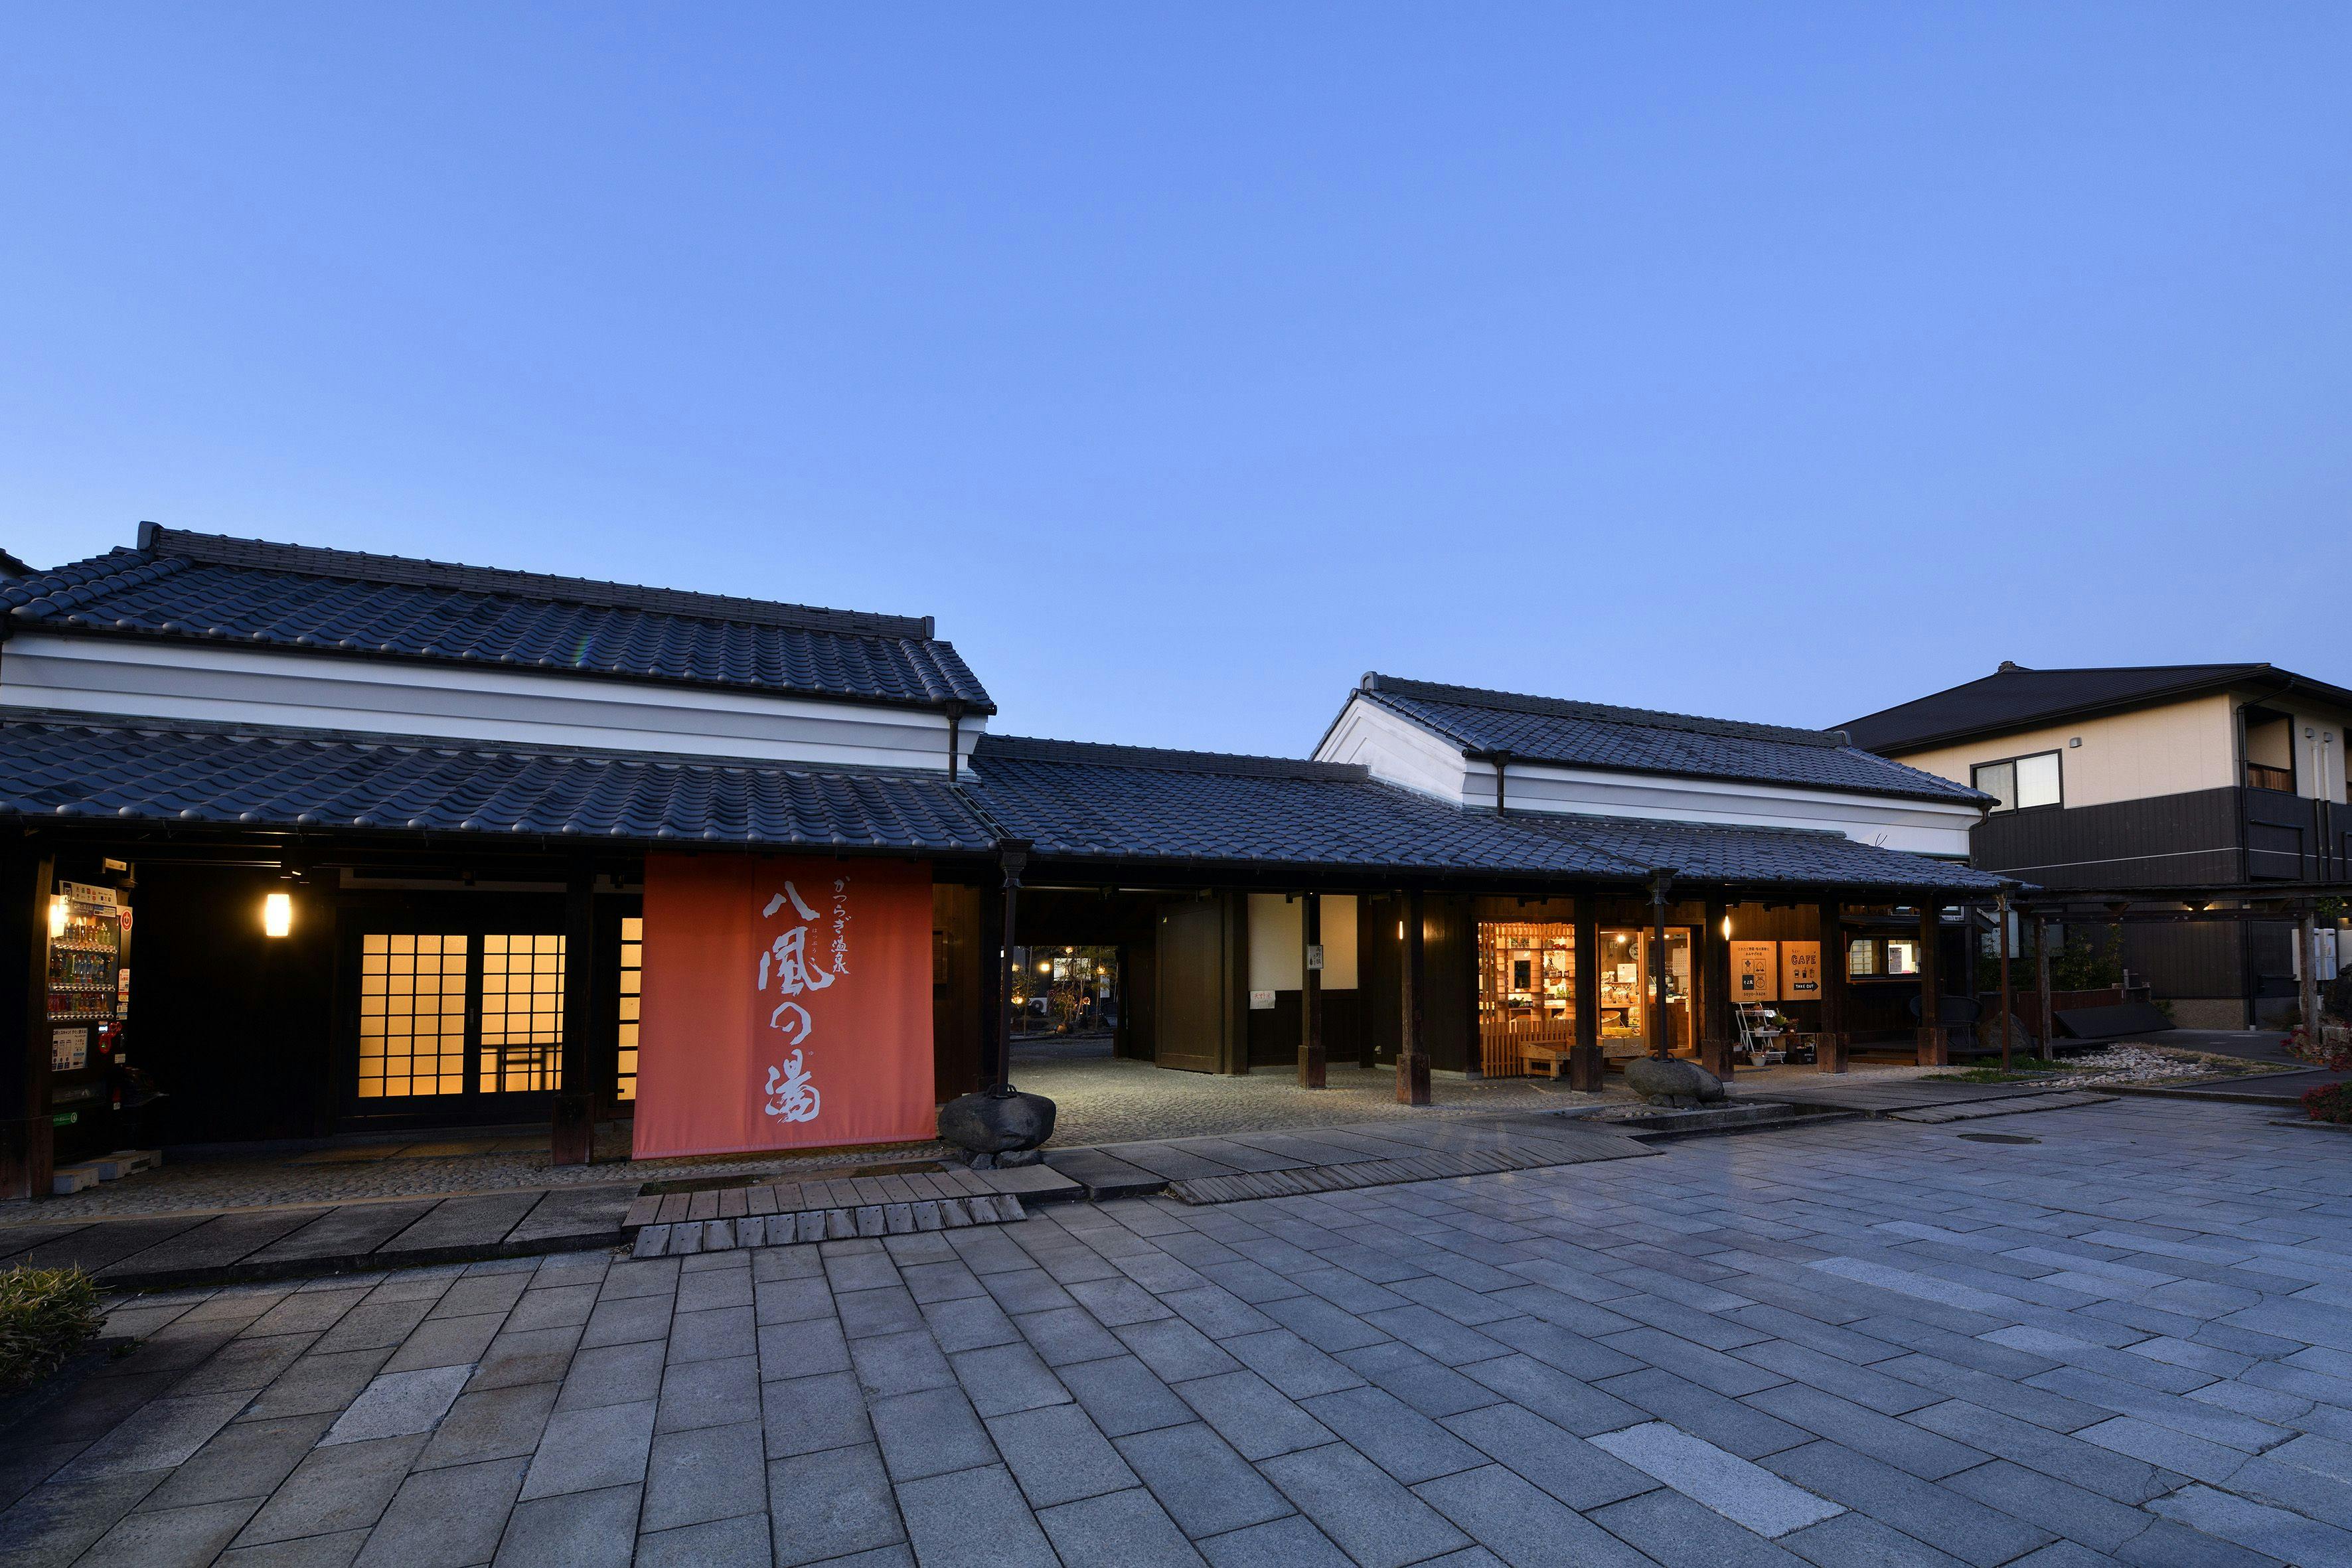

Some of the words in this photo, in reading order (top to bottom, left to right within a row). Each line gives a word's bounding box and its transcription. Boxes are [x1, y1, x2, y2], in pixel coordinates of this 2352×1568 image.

[758, 880, 836, 1123] 八風の湯
[831, 876, 851, 975] かつらぎ温泉
